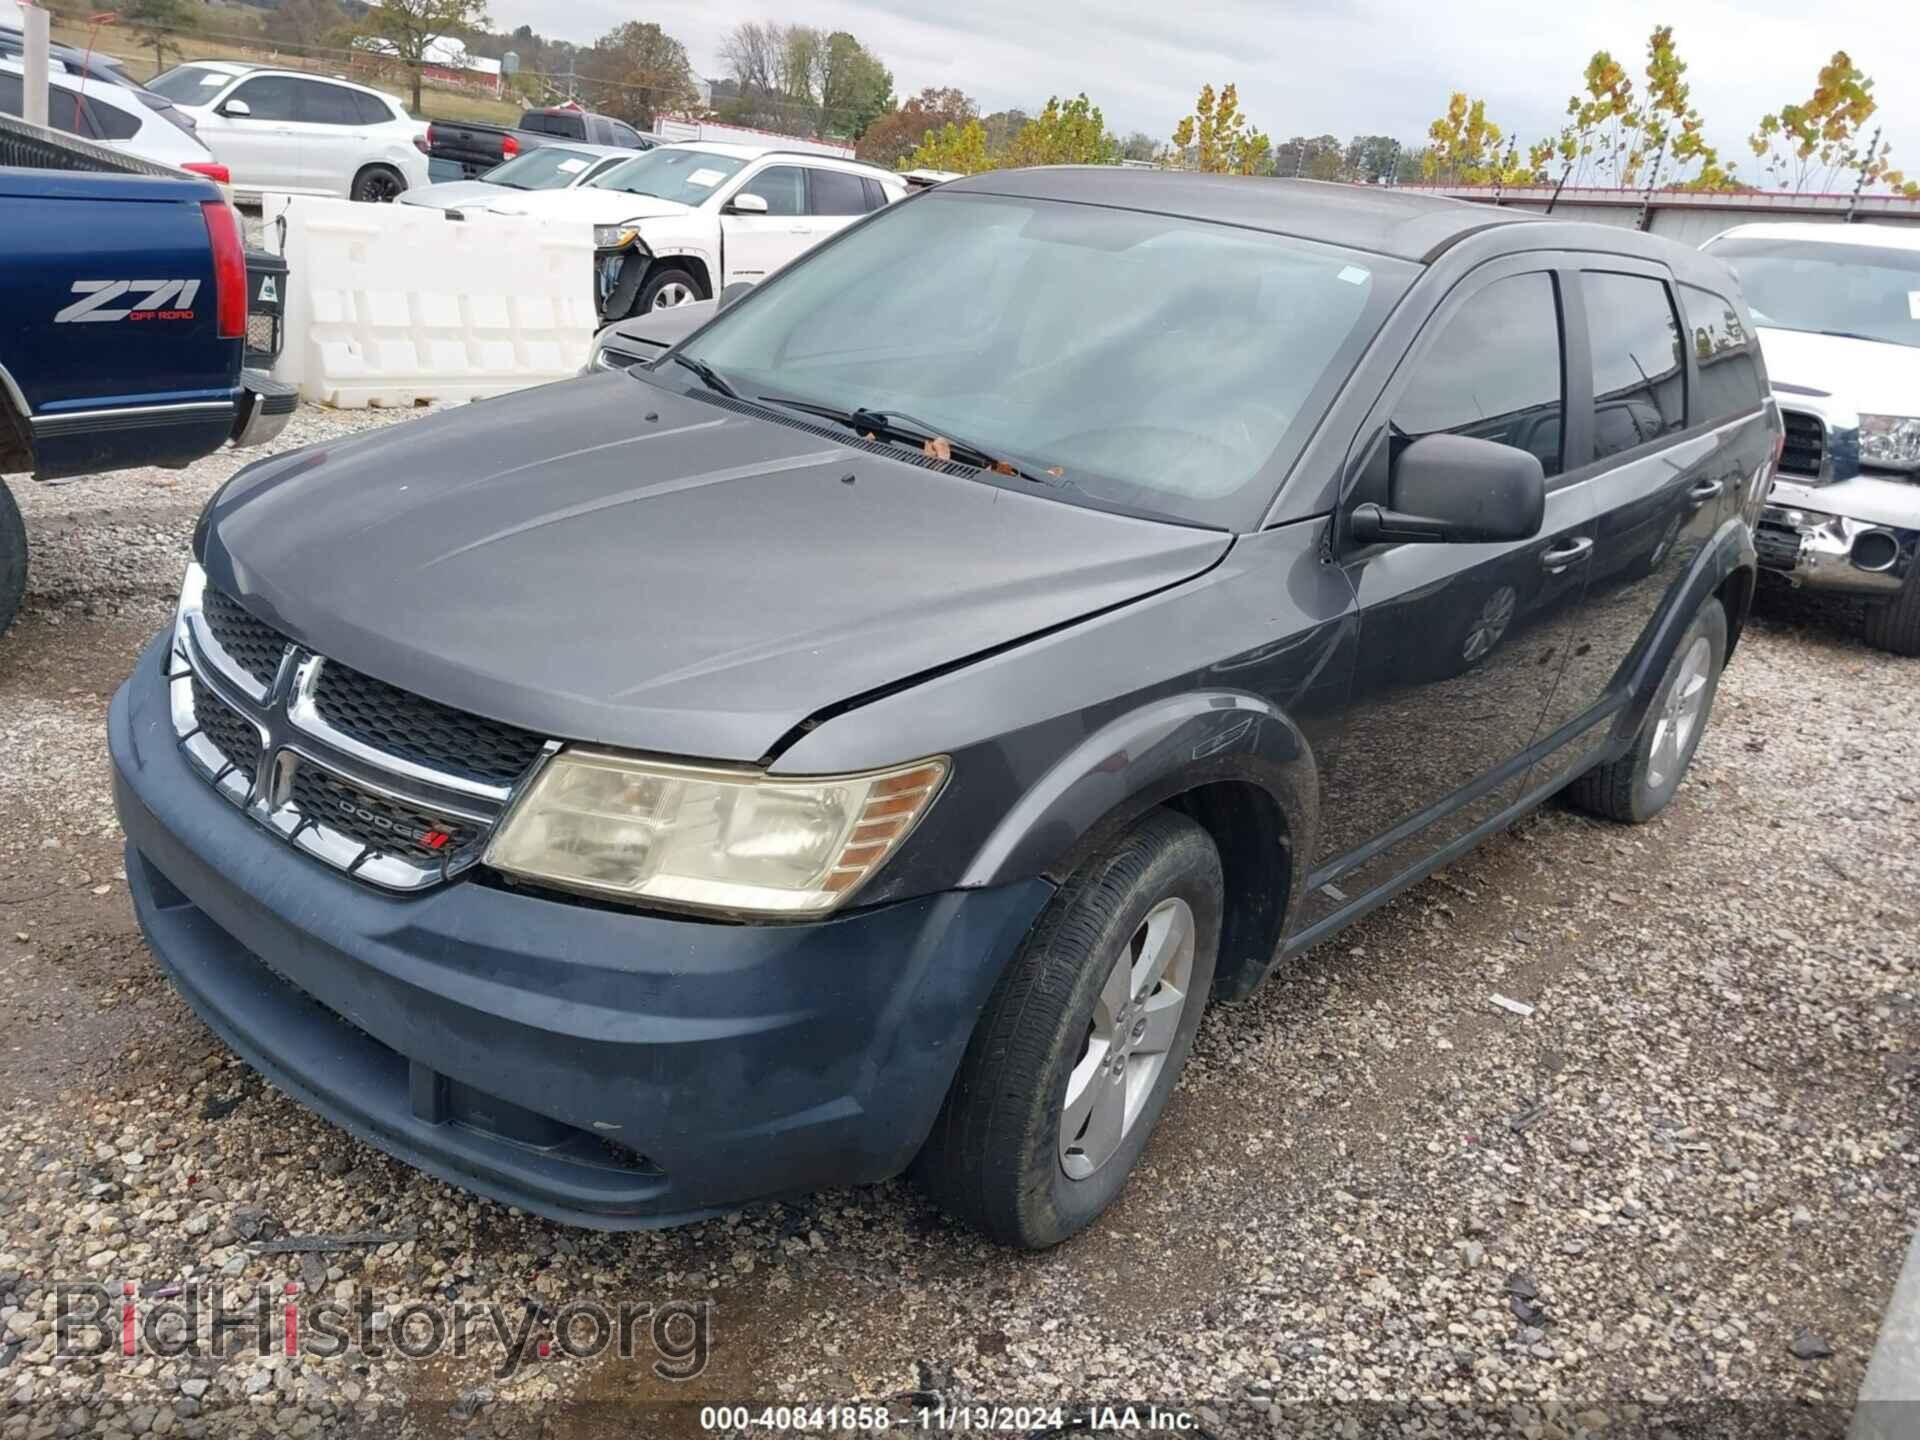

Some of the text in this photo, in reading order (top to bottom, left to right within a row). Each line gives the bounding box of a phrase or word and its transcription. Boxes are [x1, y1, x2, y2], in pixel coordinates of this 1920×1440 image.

[54, 279, 201, 323] Z71
[130, 310, 194, 320] OFF ROAD
[339, 800, 432, 844] DODGE
